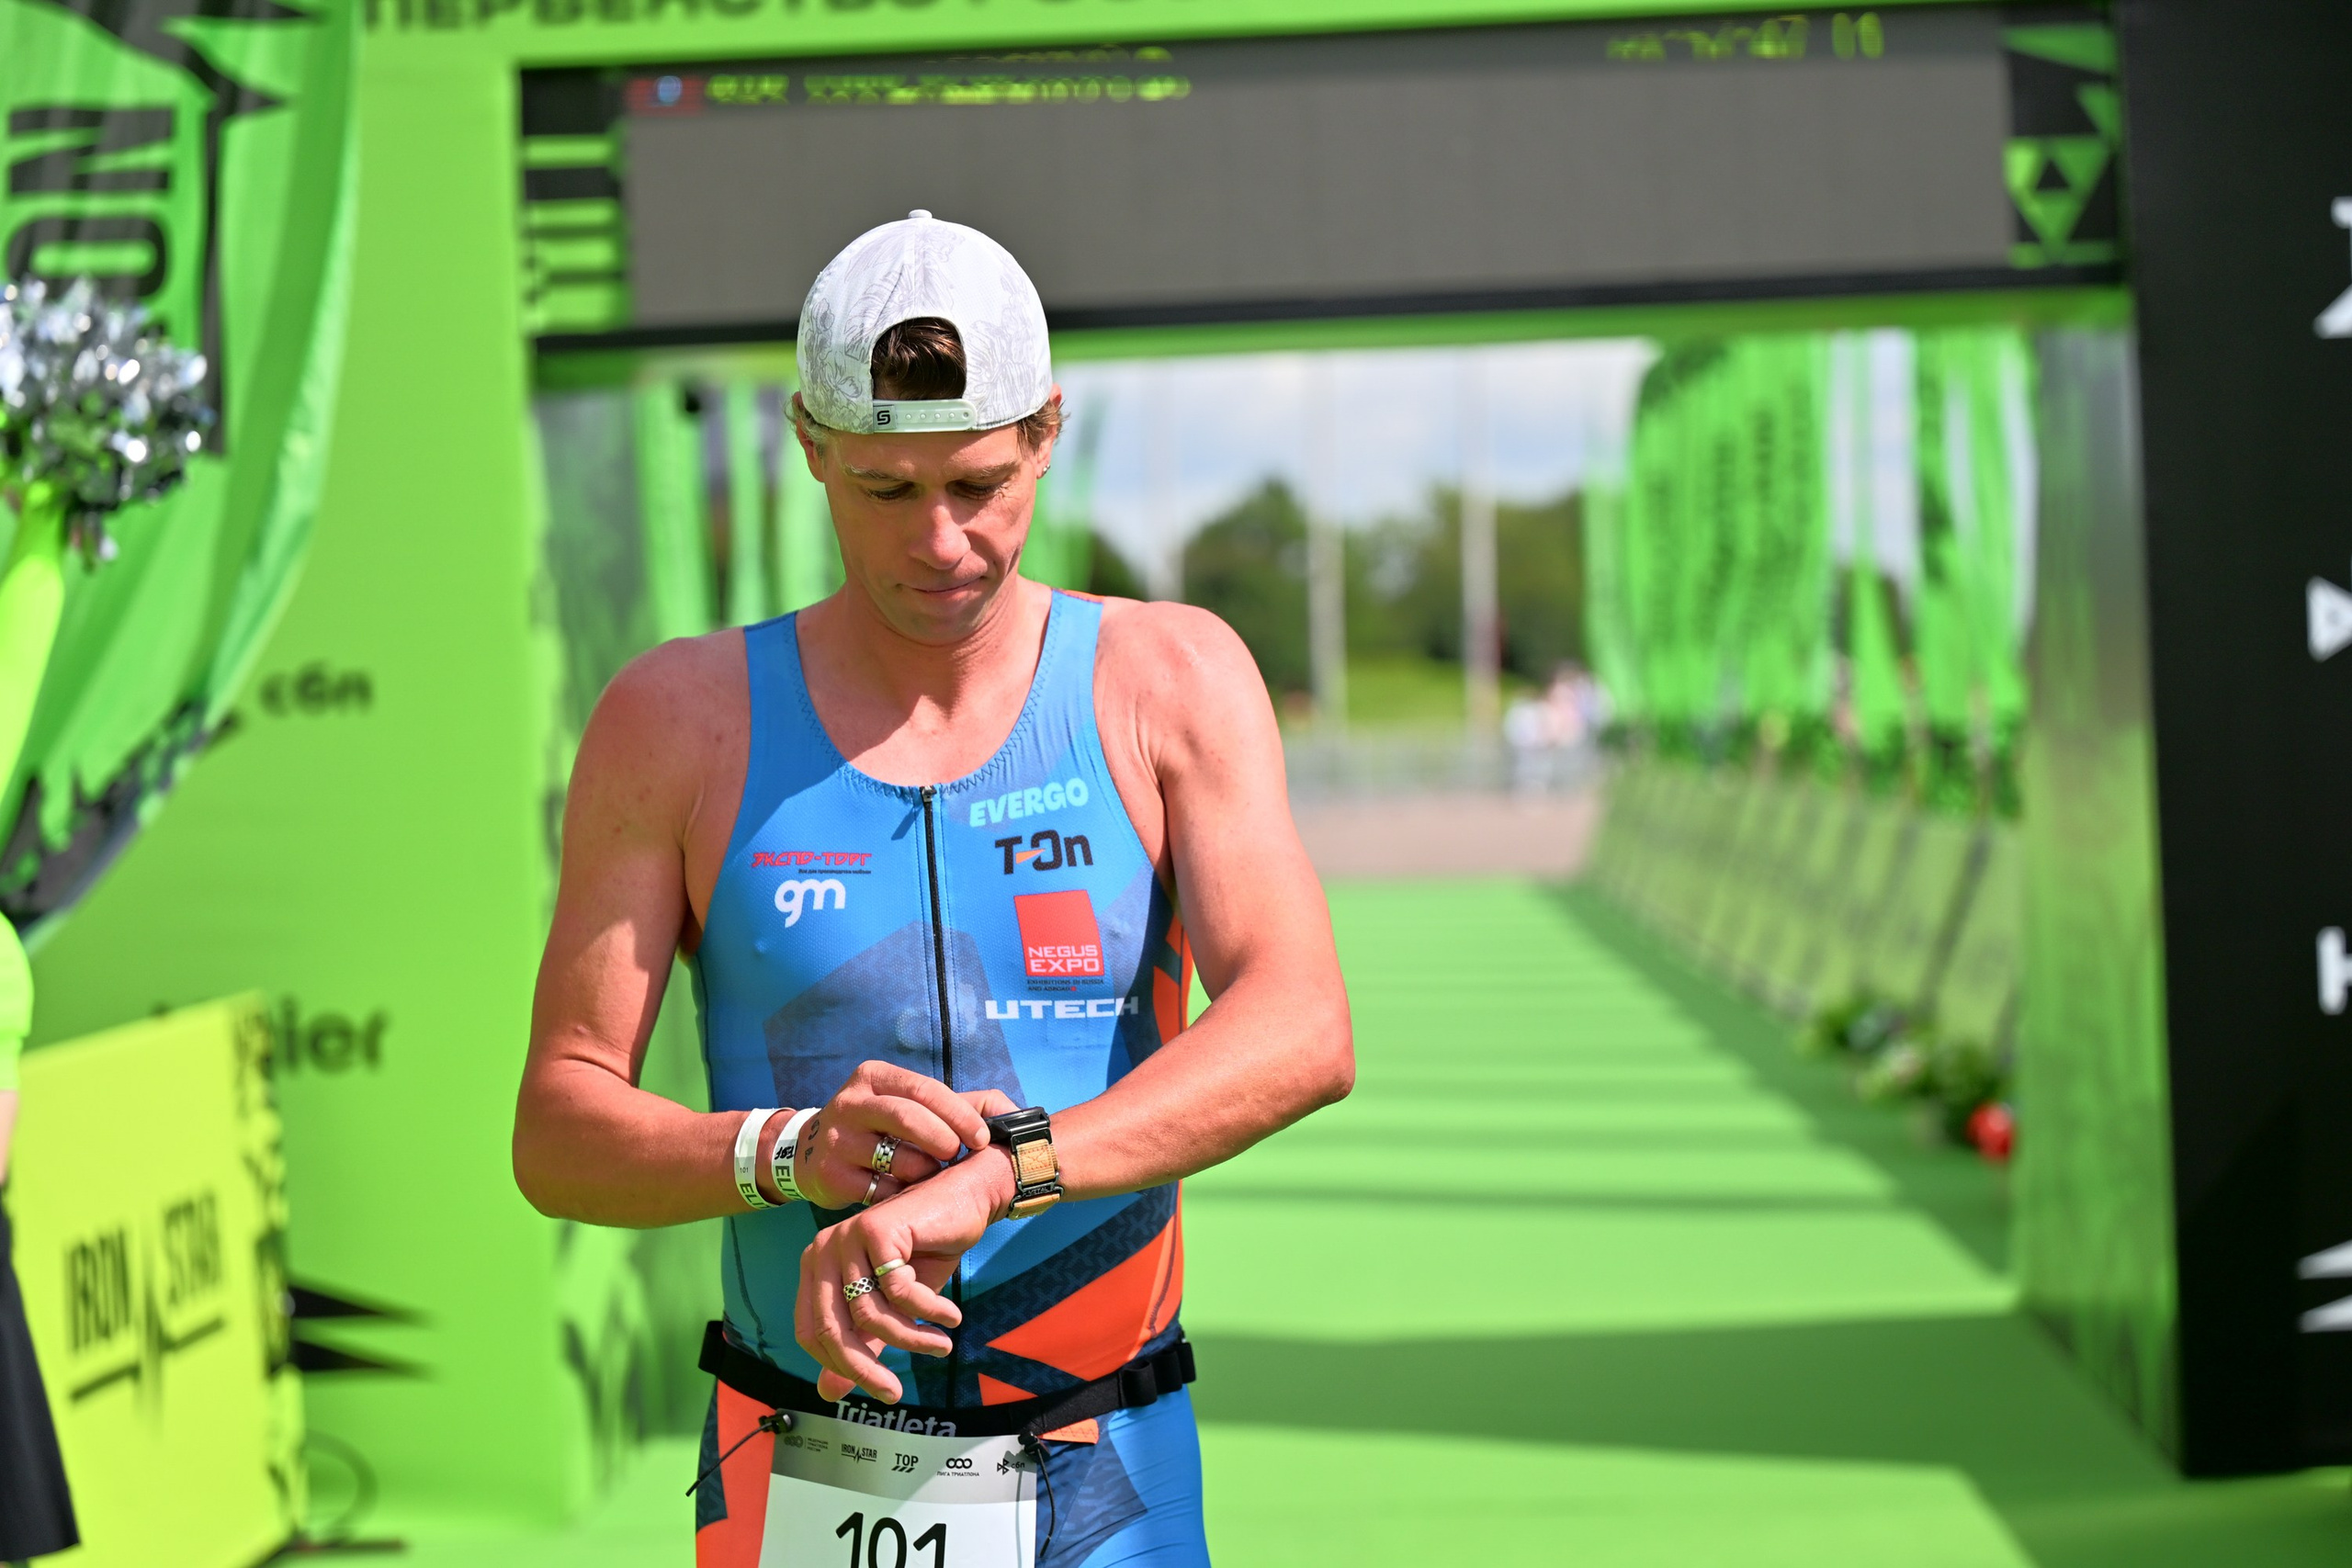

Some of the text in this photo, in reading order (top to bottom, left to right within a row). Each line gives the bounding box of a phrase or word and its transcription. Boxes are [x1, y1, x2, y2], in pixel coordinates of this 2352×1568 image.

[969, 777, 1090, 828] EVERGO
[775, 878, 846, 929] gm
[1028, 944, 1098, 958] NEGUS
[1030, 958, 1100, 973] EXPO
[985, 996, 1139, 1020] UTECH
[775, 1166, 803, 1201] ELIT
[62, 1226, 132, 1356] IRON
[835, 1400, 957, 1437] Triatleta
[841, 1443, 865, 1454] IRON
[862, 1448, 877, 1459] STAR
[895, 1453, 919, 1467] TOP
[835, 1511, 947, 1568] 101
